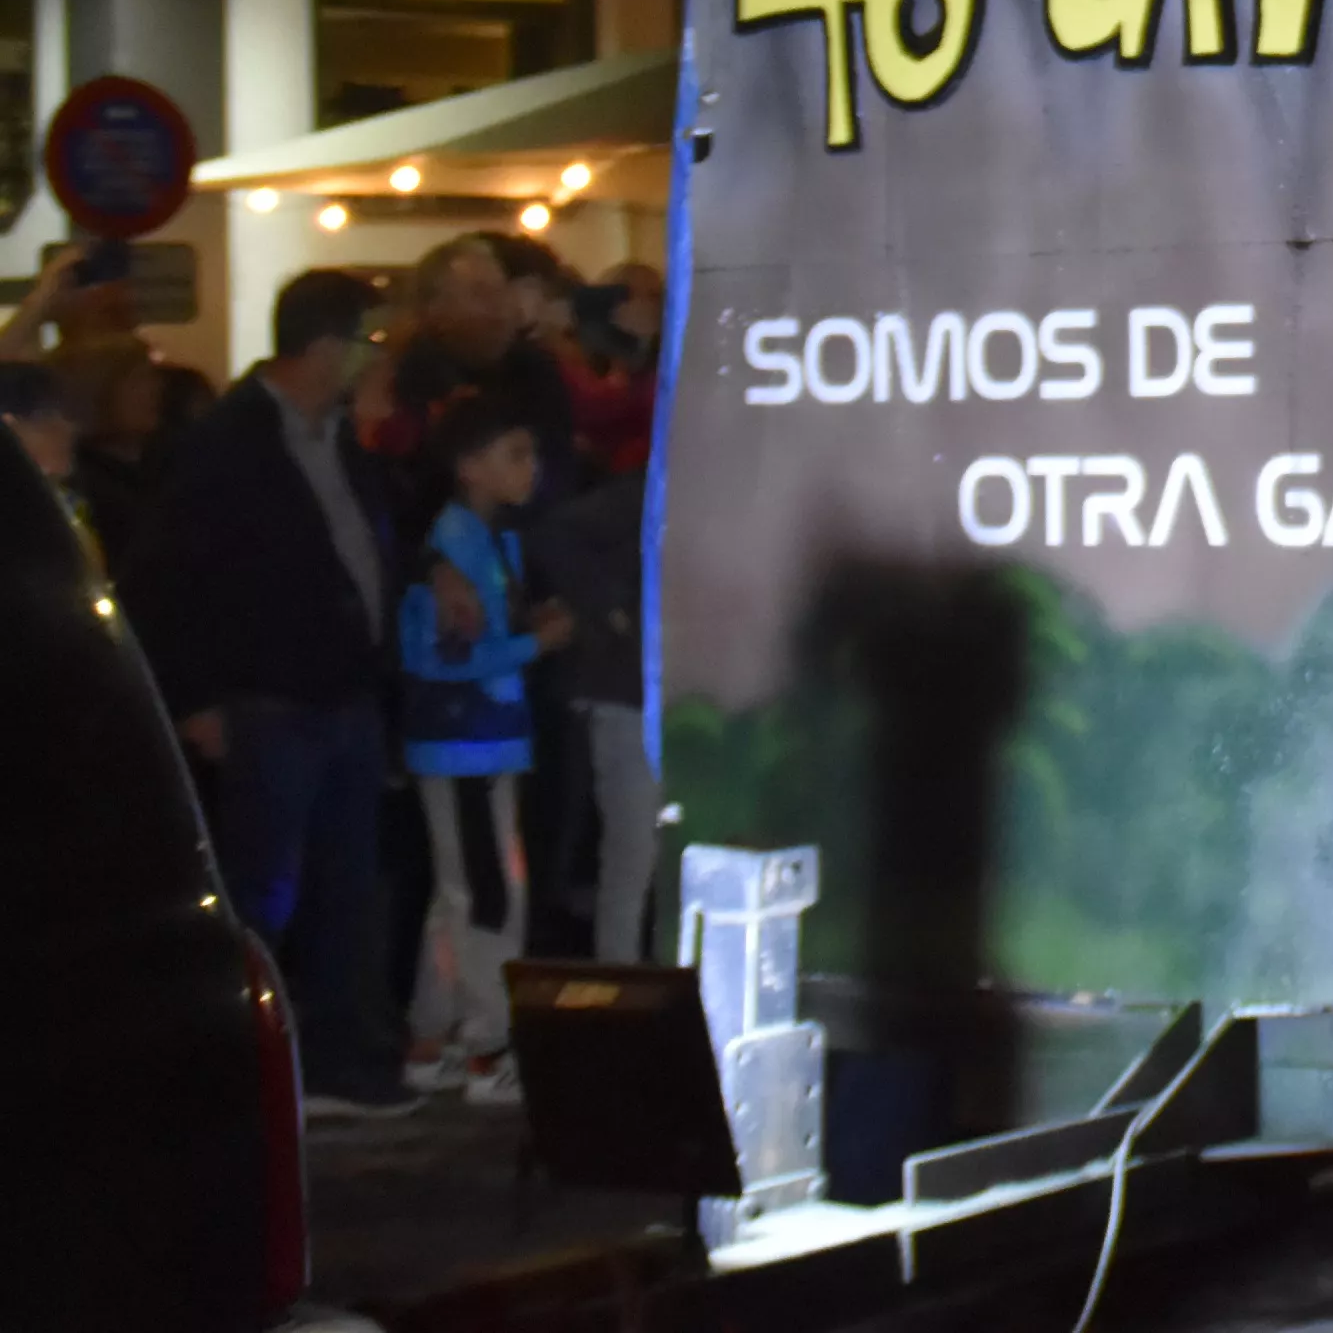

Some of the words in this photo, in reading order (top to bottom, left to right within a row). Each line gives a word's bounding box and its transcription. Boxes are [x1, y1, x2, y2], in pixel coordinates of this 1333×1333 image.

[744, 308, 1102, 406] SOMOS
[1128, 303, 1257, 398] DE
[957, 453, 1229, 548] OTRA
